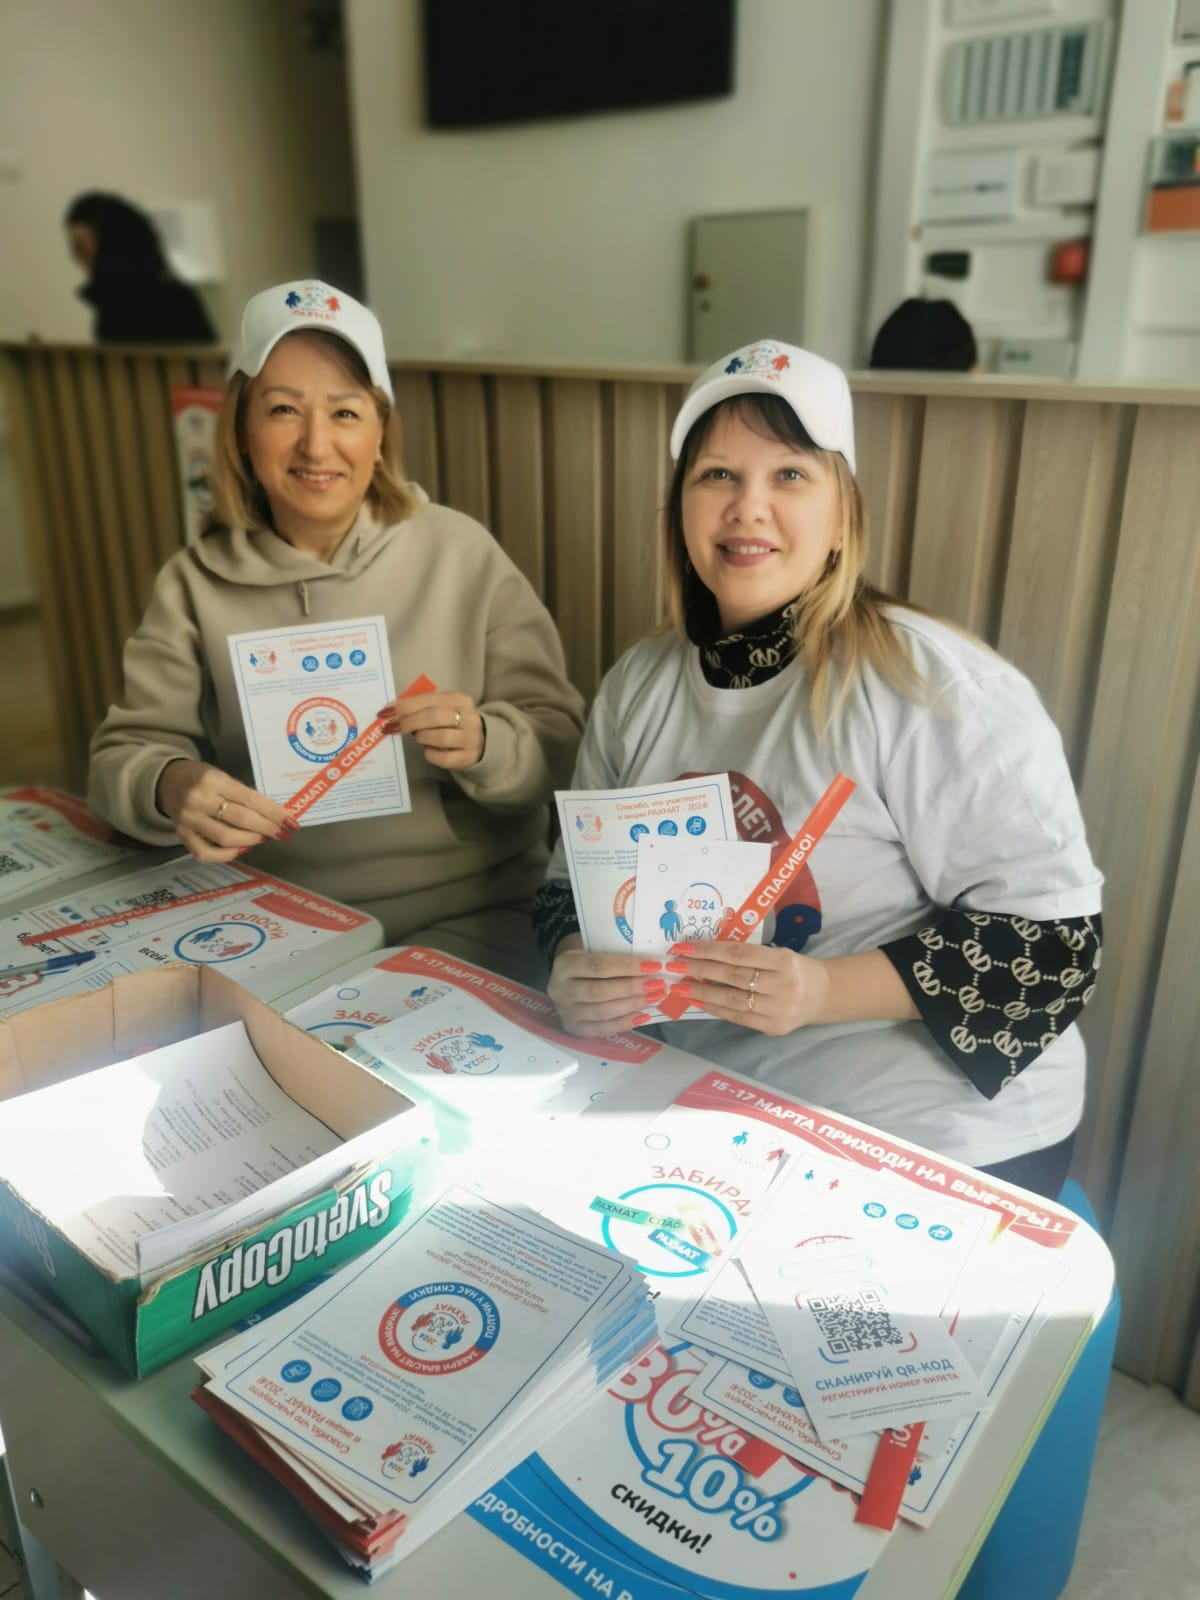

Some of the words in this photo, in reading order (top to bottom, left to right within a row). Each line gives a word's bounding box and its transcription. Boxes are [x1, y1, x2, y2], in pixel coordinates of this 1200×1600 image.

[287, 780, 328, 817] АХМАТ!
[757, 833, 816, 908] СПАСИБО!
[687, 899, 715, 911] 2024
[219, 912, 290, 941] ГОЛОСУЙ
[444, 963, 485, 987] МАРТА
[484, 979, 551, 1015] ПРИХОДИ
[333, 1009, 393, 1024] ЗАБИ
[412, 1026, 465, 1054] РАХМАТ
[464, 1054, 490, 1070] 2024
[755, 1097, 816, 1132] МАРТА
[817, 1122, 914, 1172] ПРИХОДИ
[916, 1165, 946, 1187] НА
[594, 1200, 640, 1219] РАХМАТ
[191, 1169, 393, 1321] SvetoCopy
[455, 1284, 479, 1299] НАС
[433, 1303, 470, 1325] РАХМАТ
[482, 1301, 495, 1337] ПОЛУЧИ
[390, 1346, 401, 1358] НА
[399, 1355, 441, 1371] БРАСЛЕТ
[443, 1350, 478, 1369] ЗАБЕРИ
[815, 1365, 893, 1391] СКАНИРУЙ
[896, 1359, 955, 1377] QR-КОД
[821, 1384, 888, 1403] РЕГИСТРИРУЙ
[889, 1379, 922, 1391] НОМЕР
[923, 1373, 959, 1385] БИЛЕТА
[285, 1394, 328, 1423] РАХМАТ
[763, 1398, 807, 1429] РАХМАТ
[306, 1423, 353, 1455] Спасибо,
[641, 1438, 783, 1542] 10%
[475, 1491, 583, 1575] ДРОБНОСТИ
[584, 1569, 615, 1593] НА
